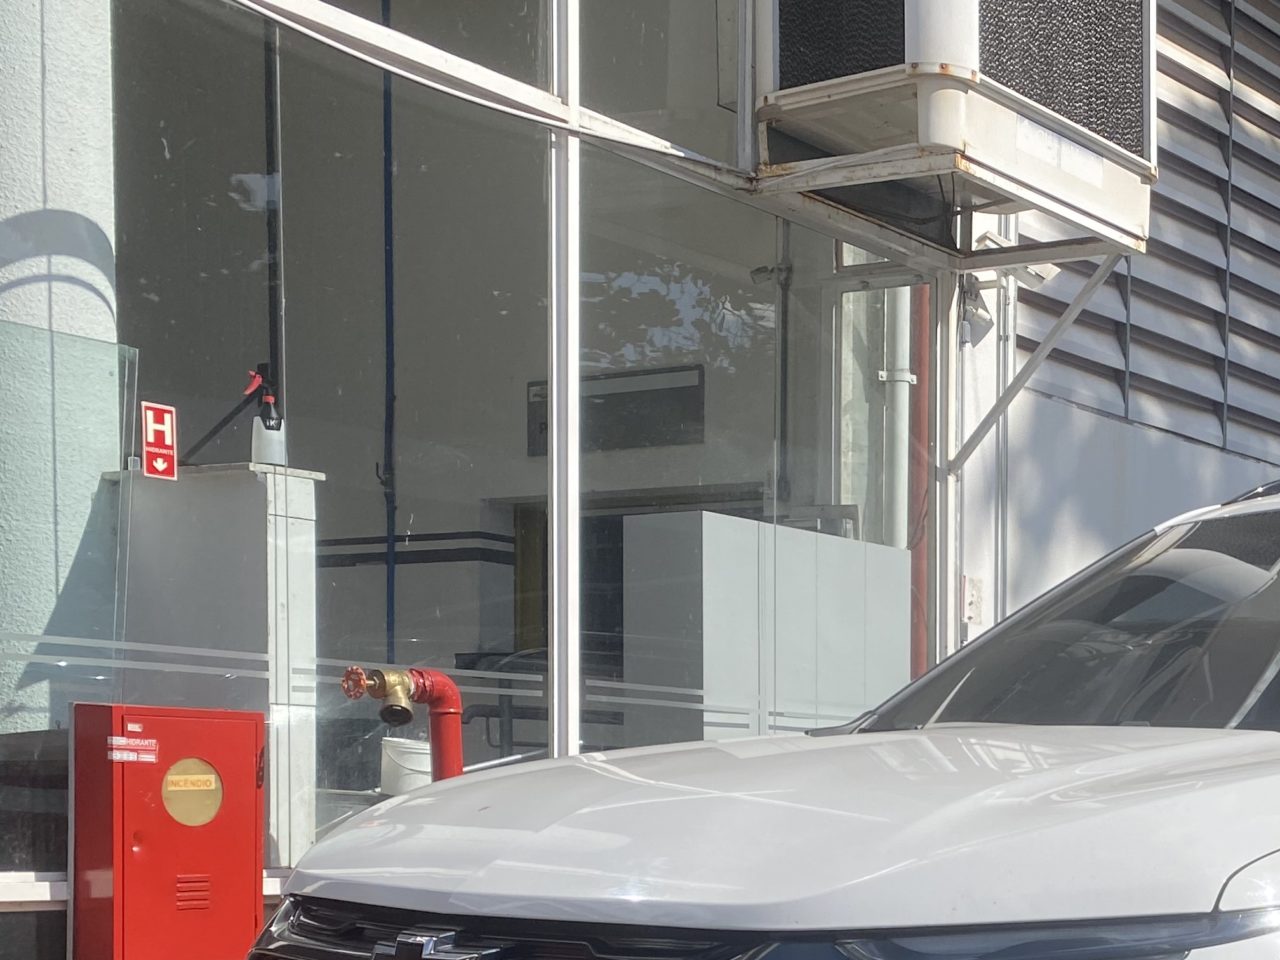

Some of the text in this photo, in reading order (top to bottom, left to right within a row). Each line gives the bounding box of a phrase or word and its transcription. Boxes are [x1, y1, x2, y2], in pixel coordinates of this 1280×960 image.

[146, 409, 172, 446] H
[145, 446, 174, 456] HIDRANTE
[127, 738, 157, 747] HIDRANTE
